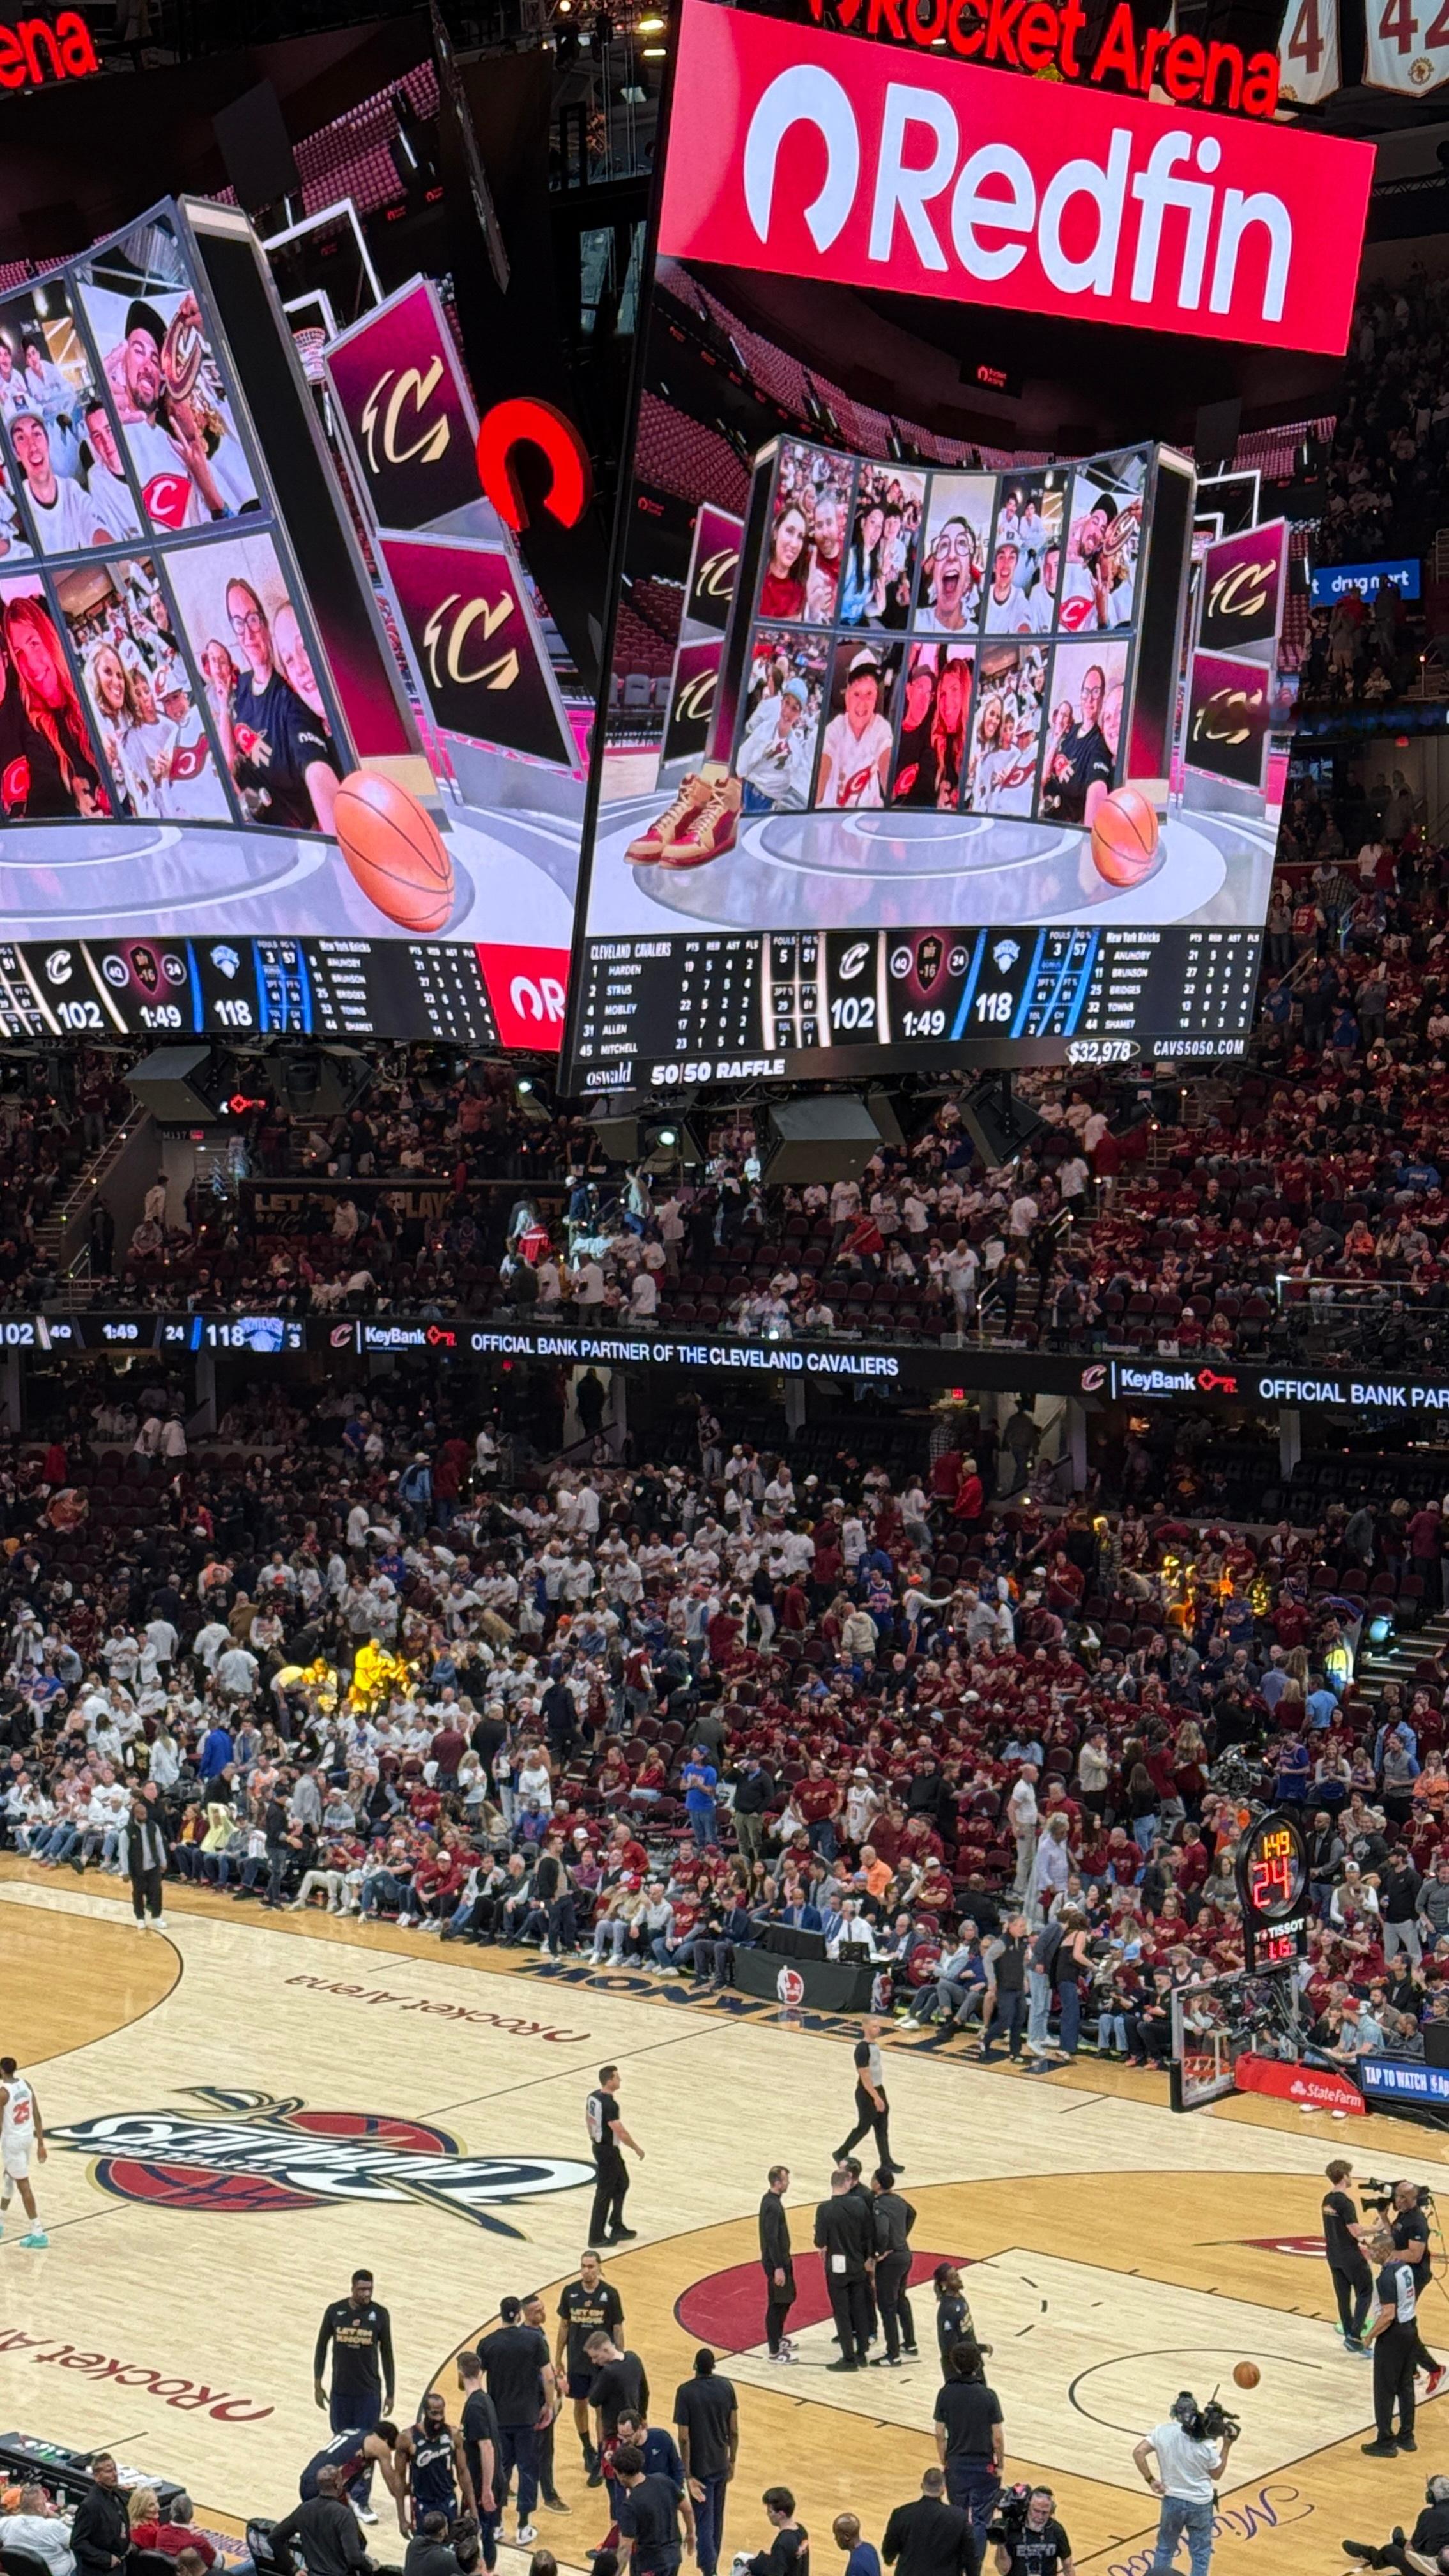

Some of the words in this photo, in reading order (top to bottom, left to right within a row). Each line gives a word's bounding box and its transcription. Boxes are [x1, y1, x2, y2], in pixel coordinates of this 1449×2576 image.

[1090, 3, 1280, 118] Arena
[868, 82, 1293, 323] Redfin
[1371, 571, 1409, 588] mrt
[773, 936, 796, 946] FOULS
[1106, 932, 1122, 944] New
[1138, 932, 1160, 943] Knicks
[590, 944, 631, 960] CLEVELAND
[634, 942, 671, 958] CAVALIERS
[779, 949, 788, 963] 5
[803, 949, 815, 962] 51
[952, 954, 964, 967] 24
[1054, 943, 1061, 956] 3
[1073, 943, 1087, 956] 57
[1188, 950, 1199, 960] 21
[1227, 950, 1234, 960] 4
[166, 963, 182, 976] 24
[592, 965, 598, 977] 1
[608, 964, 641, 976] HARDEN
[725, 959, 733, 970] 4
[746, 958, 753, 970] 2
[1095, 967, 1104, 977] 11
[1186, 967, 1198, 977] 27
[588, 985, 596, 997] 2
[606, 984, 632, 996] STRUS
[682, 979, 689, 992] 9
[703, 979, 710, 991] 7
[744, 977, 751, 989] 4
[1090, 985, 1102, 995] 25
[1183, 983, 1195, 995] 22
[1222, 983, 1229, 994] 2
[1243, 983, 1250, 994] 0
[57, 1000, 105, 1029] 102
[139, 1005, 182, 1029] 1:49
[214, 999, 252, 1027] 118
[586, 1004, 594, 1016] 4
[604, 1004, 637, 1016] MOBLEY
[679, 999, 691, 1011] 22
[721, 997, 728, 1009] 2
[742, 997, 749, 1008] 2
[831, 997, 876, 1030] 102
[976, 992, 1013, 1022] 118
[1087, 1002, 1100, 1013] 32
[1220, 1000, 1227, 1011] 7
[1240, 1000, 1246, 1011] 4
[583, 1024, 594, 1038] 31
[602, 1024, 627, 1036] ALLEN
[678, 1018, 687, 1031] 17
[700, 1018, 707, 1029] 7
[719, 1016, 726, 1028] 0
[740, 1015, 747, 1027] 2
[903, 1009, 946, 1036] 1:49
[1085, 1019, 1098, 1030] 44
[1218, 1017, 1225, 1028] 3
[579, 1045, 593, 1057] 45
[601, 1043, 638, 1055] MITCHELL
[675, 1038, 687, 1050] 23
[698, 1037, 703, 1048] 1
[717, 1036, 724, 1047] 5
[738, 1035, 745, 1046] 4
[779, 1035, 786, 1046] 2
[807, 1034, 812, 1045] 1
[1069, 1041, 1131, 1066] $32,978
[1153, 1040, 1245, 1056] CAVS5050.COM
[586, 1061, 632, 1086] oswald
[716, 1059, 786, 1079] RAFFLE
[254, 1192, 303, 1213] LET
[50, 1324, 72, 1339] 4Q
[103, 1324, 139, 1340] 1:49
[165, 1325, 185, 1340] 24
[206, 1324, 245, 1347] 118
[289, 1333, 300, 1348] 3
[365, 1326, 426, 1346] KeyBank
[471, 1334, 535, 1354] OFFICIAL
[537, 1338, 578, 1358] BANK
[581, 1342, 650, 1362] PARTNER
[653, 1345, 674, 1363] OF
[677, 1346, 708, 1365] THE
[710, 1348, 803, 1371] CLEVELAND
[806, 1353, 899, 1376] CAVALIERS
[1121, 1368, 1195, 1392] KeyBank
[1259, 1379, 1346, 1403] OFFICIAL
[1351, 1386, 1407, 1407] BANK
[1263, 1831, 1291, 1860] 1:49
[1253, 1856, 1290, 1908] 24
[1268, 1918, 1305, 1938] TISSOT
[284, 1974, 390, 2005] Arena
[405, 2000, 545, 2037] Rocket
[1364, 2066, 1382, 2085] TAP
[1383, 2069, 1395, 2087] TO
[1395, 2070, 1427, 2091] WATCH
[13, 2100, 30, 2125] 25
[45, 2115, 598, 2204] CAVALIERS
[91, 2142, 289, 2174] CLEVELAND
[30, 2345, 224, 2411] Rocket
